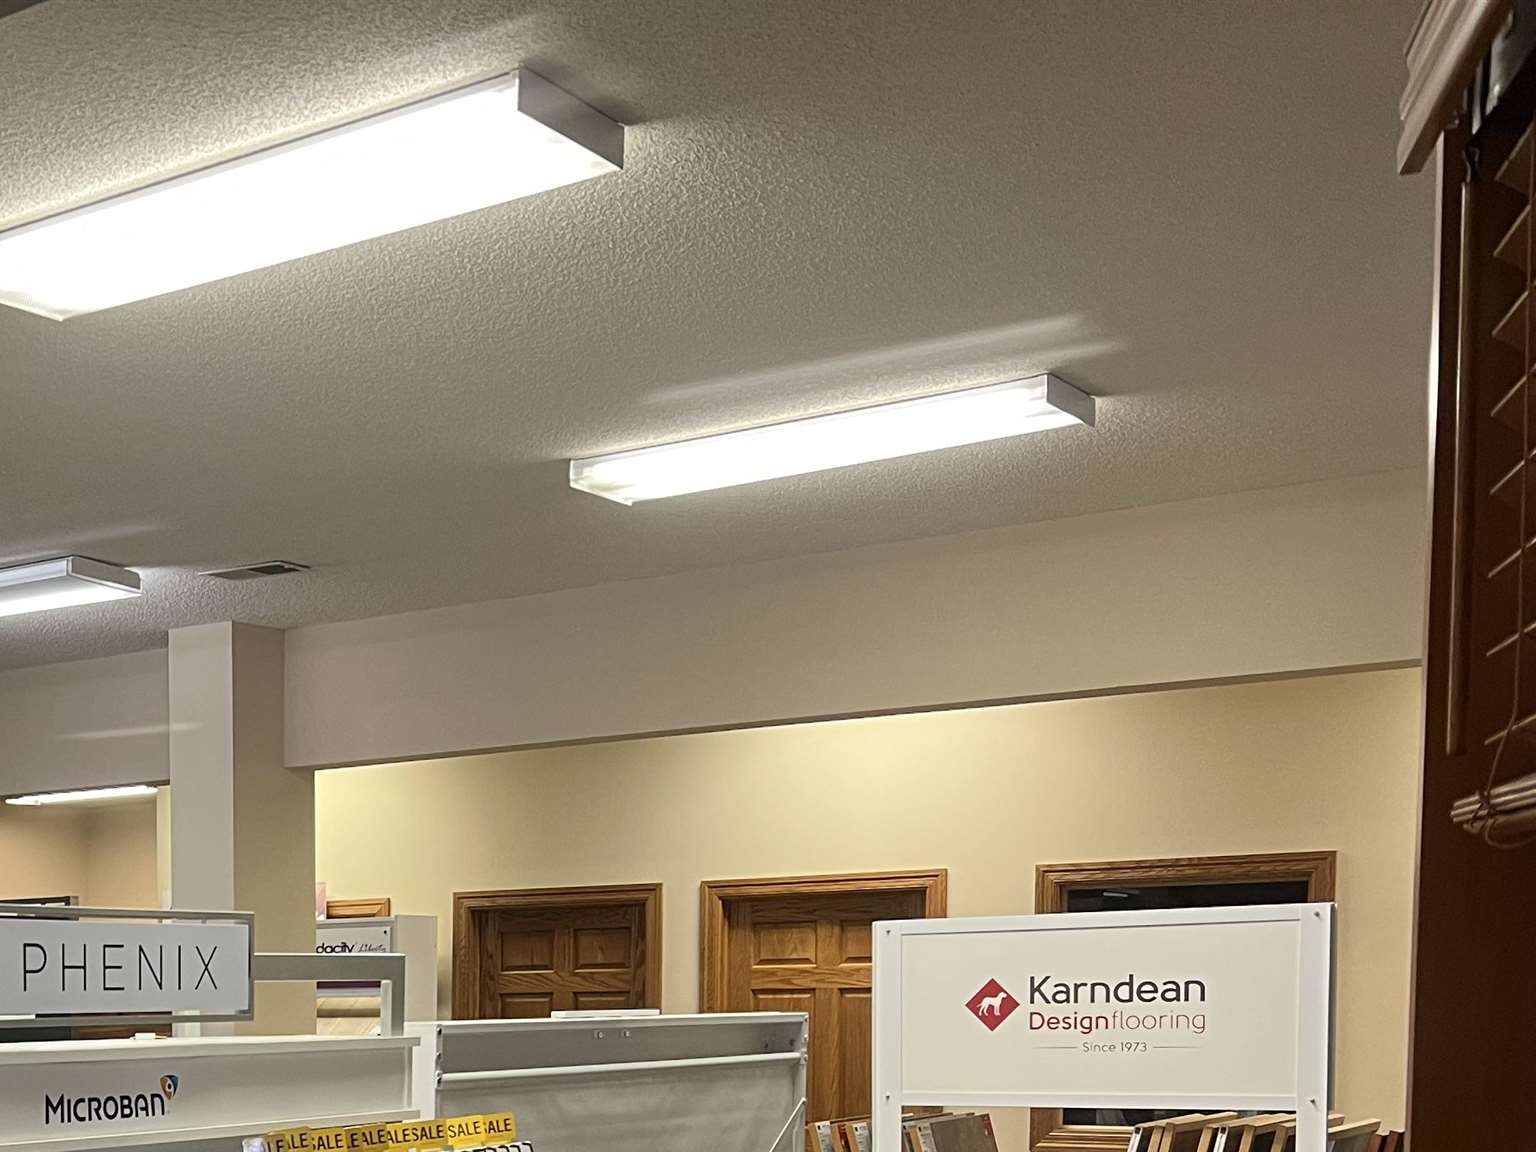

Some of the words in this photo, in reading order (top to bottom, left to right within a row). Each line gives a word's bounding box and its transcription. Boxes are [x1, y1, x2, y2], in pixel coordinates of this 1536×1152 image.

[23, 942, 218, 992] PHENIX
[1029, 974, 1206, 1005] Karndean
[1029, 1010, 1206, 1035] Designflooring
[1082, 1041, 1117, 1053] Since
[1120, 1041, 1148, 1053] 1973
[387, 1127, 412, 1144] ALE
[411, 1123, 445, 1142] SALE
[447, 1120, 482, 1139] SALE
[484, 1117, 513, 1135] ALE
[311, 1133, 344, 1152] ALE
